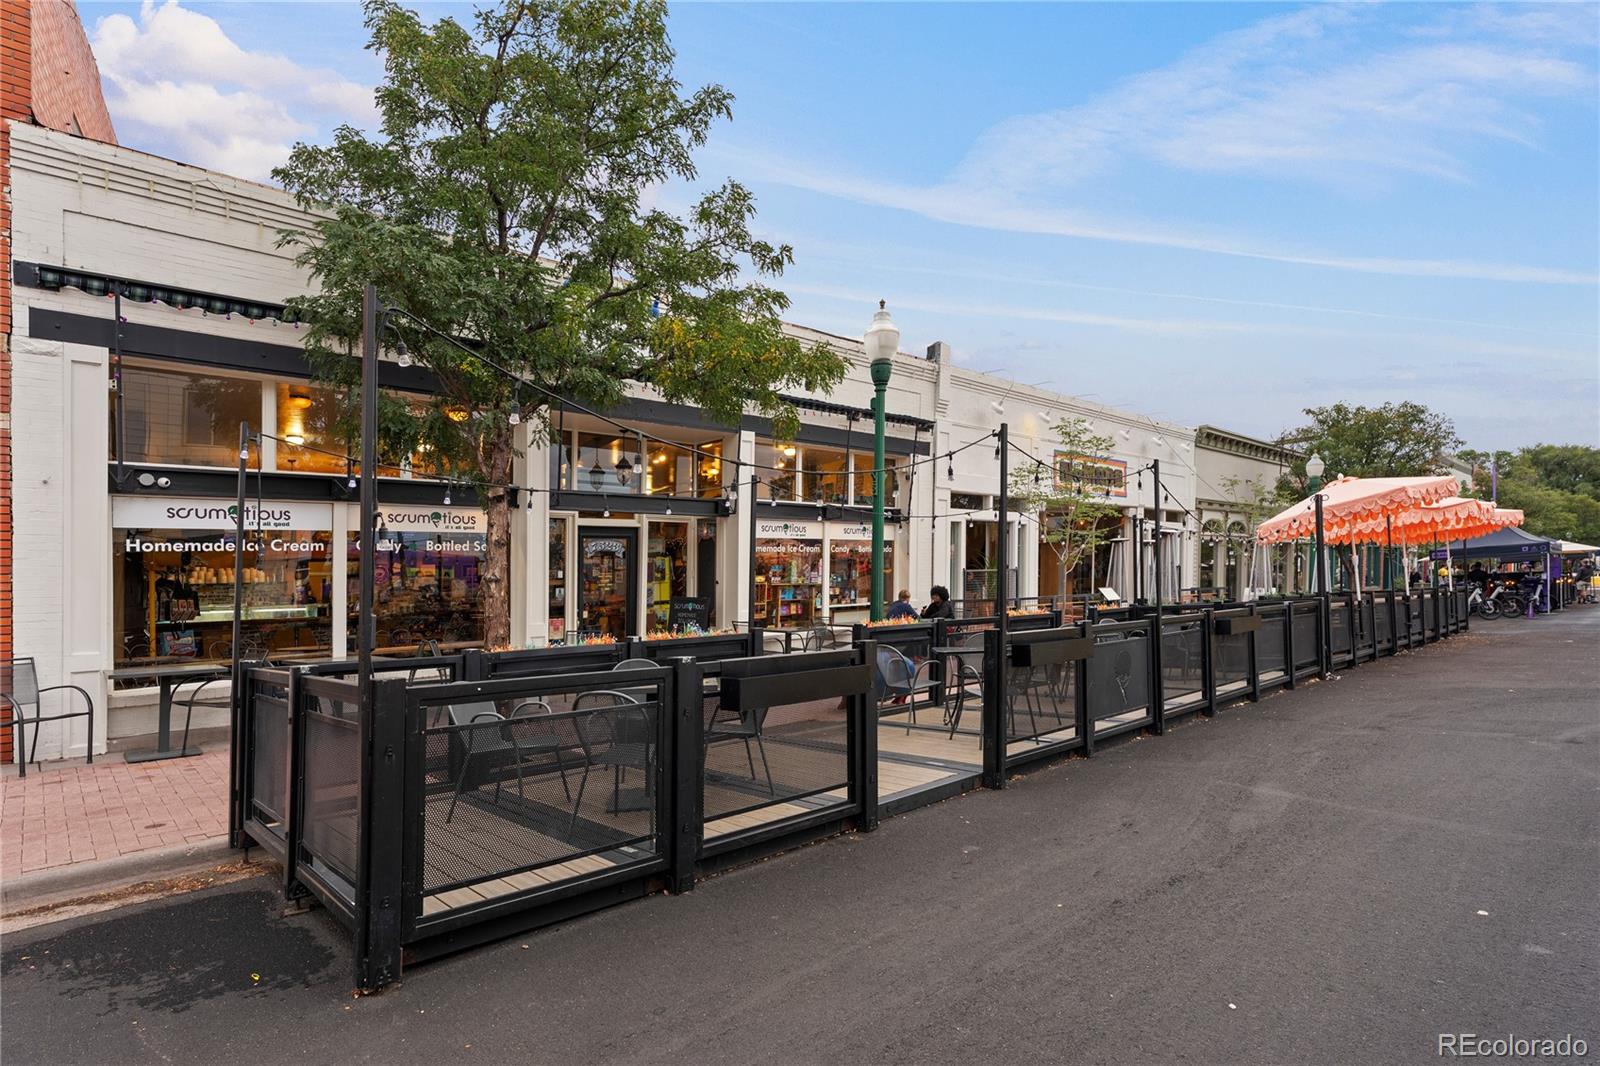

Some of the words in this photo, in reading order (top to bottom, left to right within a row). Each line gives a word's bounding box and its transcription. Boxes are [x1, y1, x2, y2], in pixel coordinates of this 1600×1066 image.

[125, 539, 236, 553] Homemade
[270, 539, 325, 552] Cream
[426, 540, 470, 552] Bottled
[755, 543, 786, 553] memade
[798, 544, 821, 553] Cream
[830, 544, 850, 554] Candy
